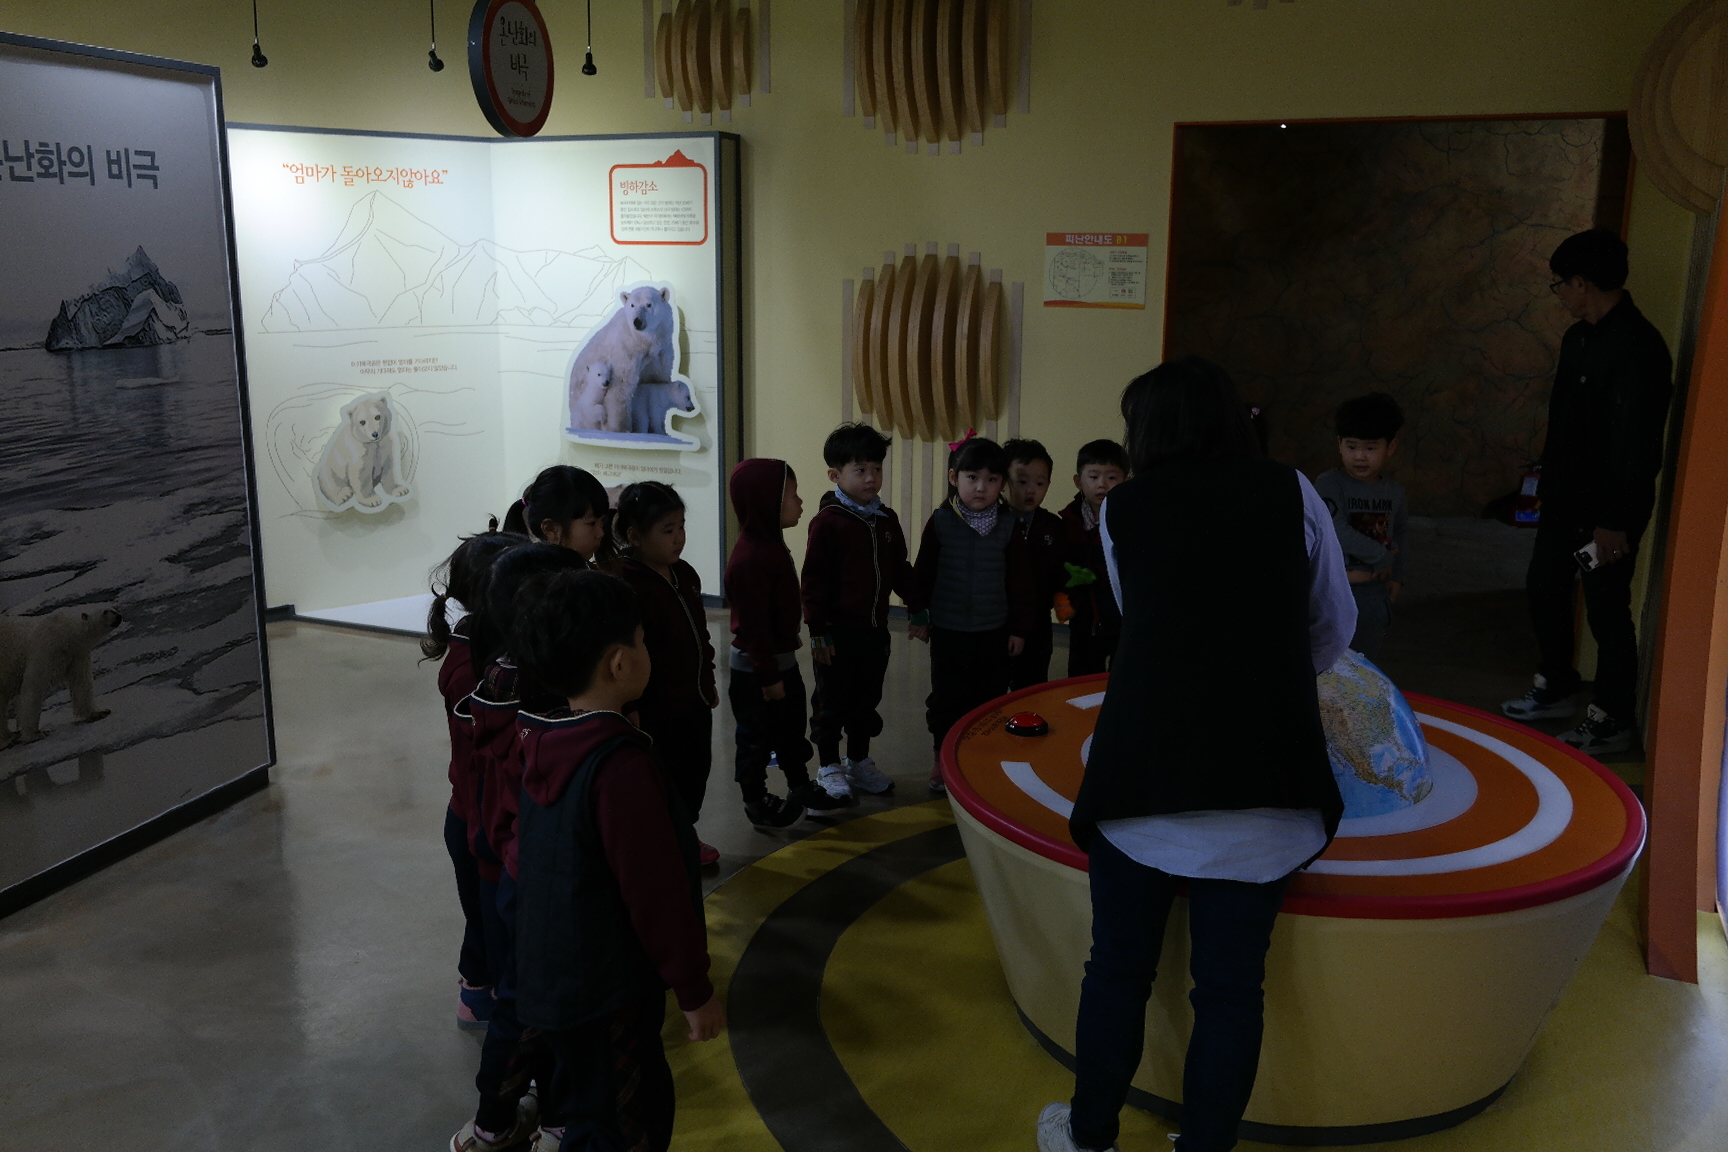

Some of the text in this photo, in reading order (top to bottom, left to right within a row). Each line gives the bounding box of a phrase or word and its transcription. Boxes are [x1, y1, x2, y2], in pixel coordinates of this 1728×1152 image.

[500, 16, 536, 47] 온난화의
[510, 53, 529, 81] 비극
[0, 139, 160, 189] 난화의 비극
[619, 180, 658, 196] 빙하감소
[1065, 234, 1127, 245] 피난안내도 B1
[1347, 497, 1393, 511] IRON MAN
